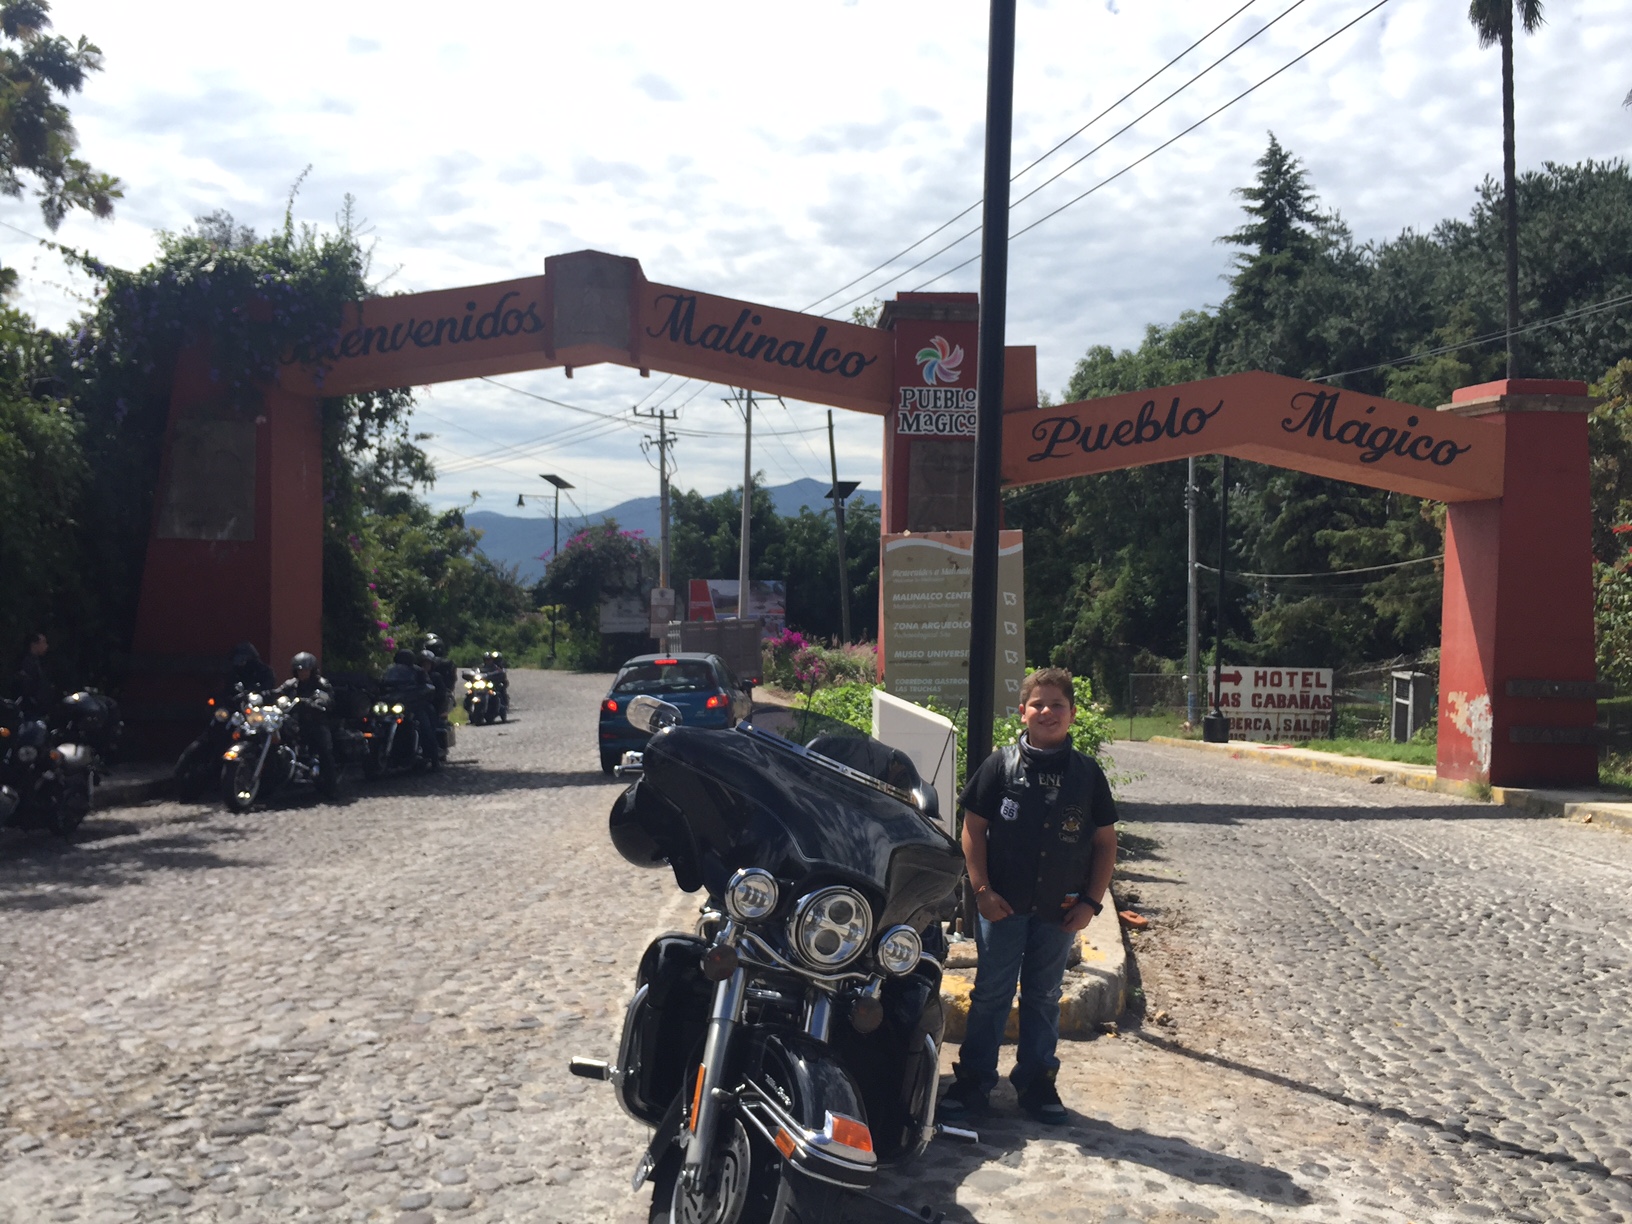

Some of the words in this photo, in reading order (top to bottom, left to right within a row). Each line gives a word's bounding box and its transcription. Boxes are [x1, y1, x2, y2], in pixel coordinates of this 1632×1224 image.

[646, 292, 876, 379] Malinalco
[900, 387, 976, 410] PUEBLO
[1027, 397, 1224, 464] Pueblo
[1281, 390, 1472, 467] Mágico
[892, 592, 943, 601] MALINALCO
[944, 591, 972, 600] CENTR
[893, 622, 919, 630] ZONA
[921, 621, 971, 630] ARQUEOLO
[894, 650, 924, 658] MUSEO
[1254, 670, 1327, 689] HOTEL
[1209, 692, 1241, 708] LAS
[1251, 690, 1332, 710] CABAÑAS
[1229, 716, 1272, 731] BERCA
[1003, 806, 1015, 818] 66
